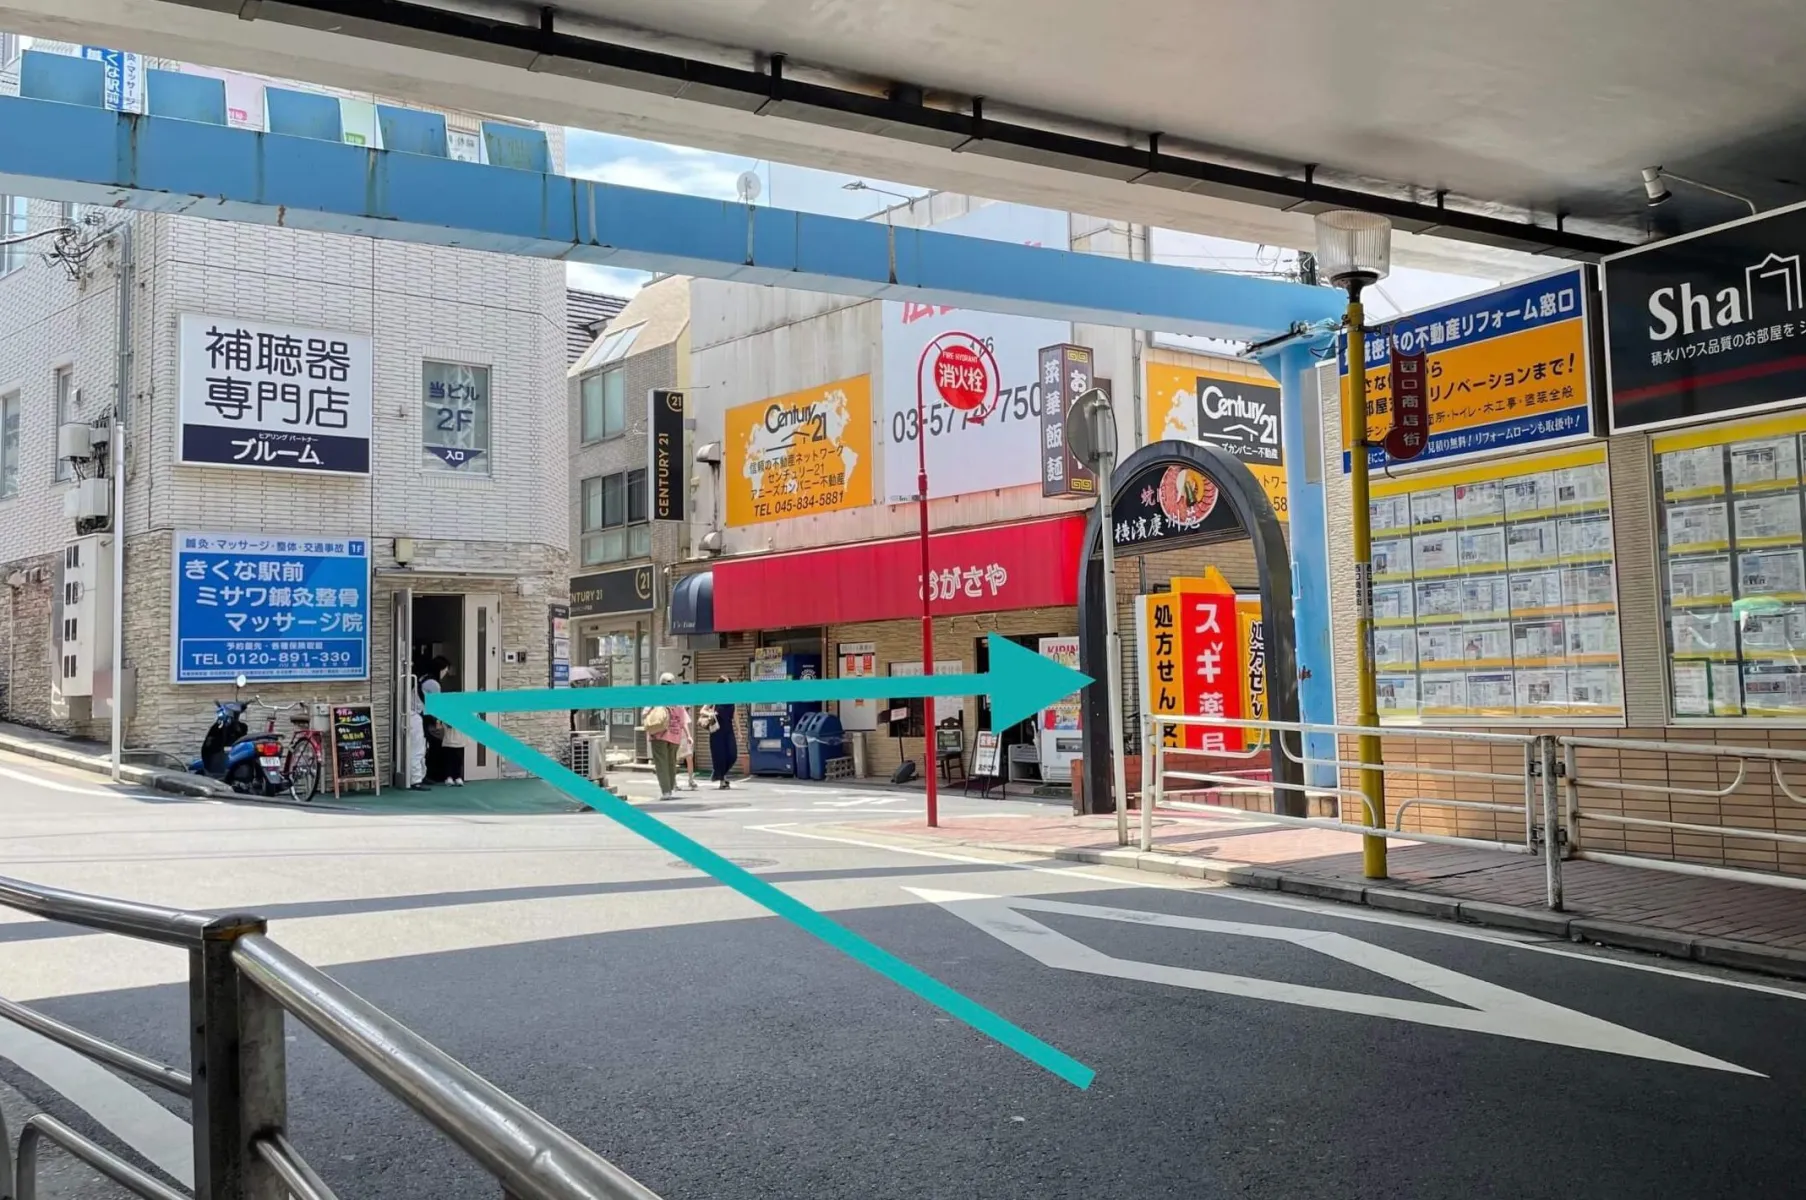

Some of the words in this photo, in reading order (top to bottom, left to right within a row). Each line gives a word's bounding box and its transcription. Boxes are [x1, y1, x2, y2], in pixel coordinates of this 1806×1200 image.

[205, 325, 350, 382] 補聴器
[942, 351, 955, 360] FIRE
[955, 353, 978, 364] HYDRANT
[939, 362, 985, 393] 消火栓
[205, 376, 350, 429] 専門店
[430, 381, 480, 401] 当ビル
[1399, 360, 1420, 446] 西口商店街
[437, 408, 473, 432] 2F
[765, 404, 817, 434] Century
[811, 411, 828, 442] 21
[1202, 385, 1266, 425] Century
[1259, 414, 1278, 445] 21
[231, 438, 321, 465] ブルーム
[658, 433, 669, 446] 21
[445, 450, 464, 461] 入口
[749, 445, 844, 475] 信頼の不動産ネットワーク
[658, 448, 669, 517] CENTURY
[768, 463, 825, 484] センチュリー21
[754, 503, 772, 517] TEL
[774, 491, 844, 513] 045-834-5881
[185, 559, 304, 582] きくな駅前
[640, 572, 650, 590] 21
[918, 563, 1008, 601] おがさや
[196, 586, 359, 608] ミサワ鍼灸整骨
[224, 612, 363, 632] マッサージ院
[192, 653, 223, 665] TEL
[227, 651, 350, 665] 0120-891-330
[1195, 603, 1226, 753] スギ薬局
